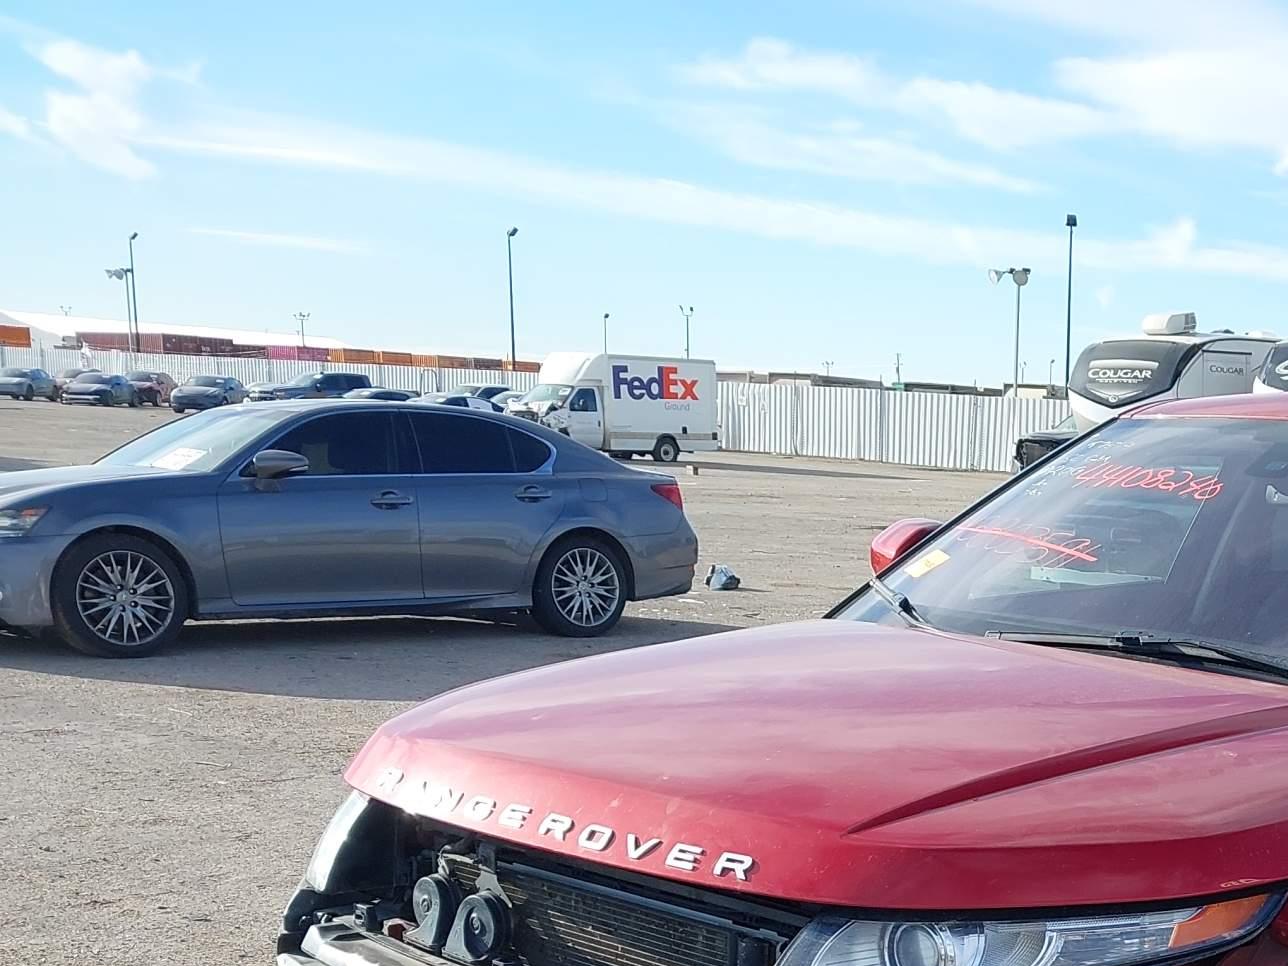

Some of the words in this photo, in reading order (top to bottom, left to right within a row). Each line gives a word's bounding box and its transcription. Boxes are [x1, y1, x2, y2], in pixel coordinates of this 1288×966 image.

[1088, 368, 1152, 379] COUGAR
[1209, 364, 1244, 376] COUGAR
[612, 365, 699, 400] FedEx
[664, 402, 691, 412] Ground
[375, 767, 533, 829] RANGE
[538, 812, 757, 882] ROVER
